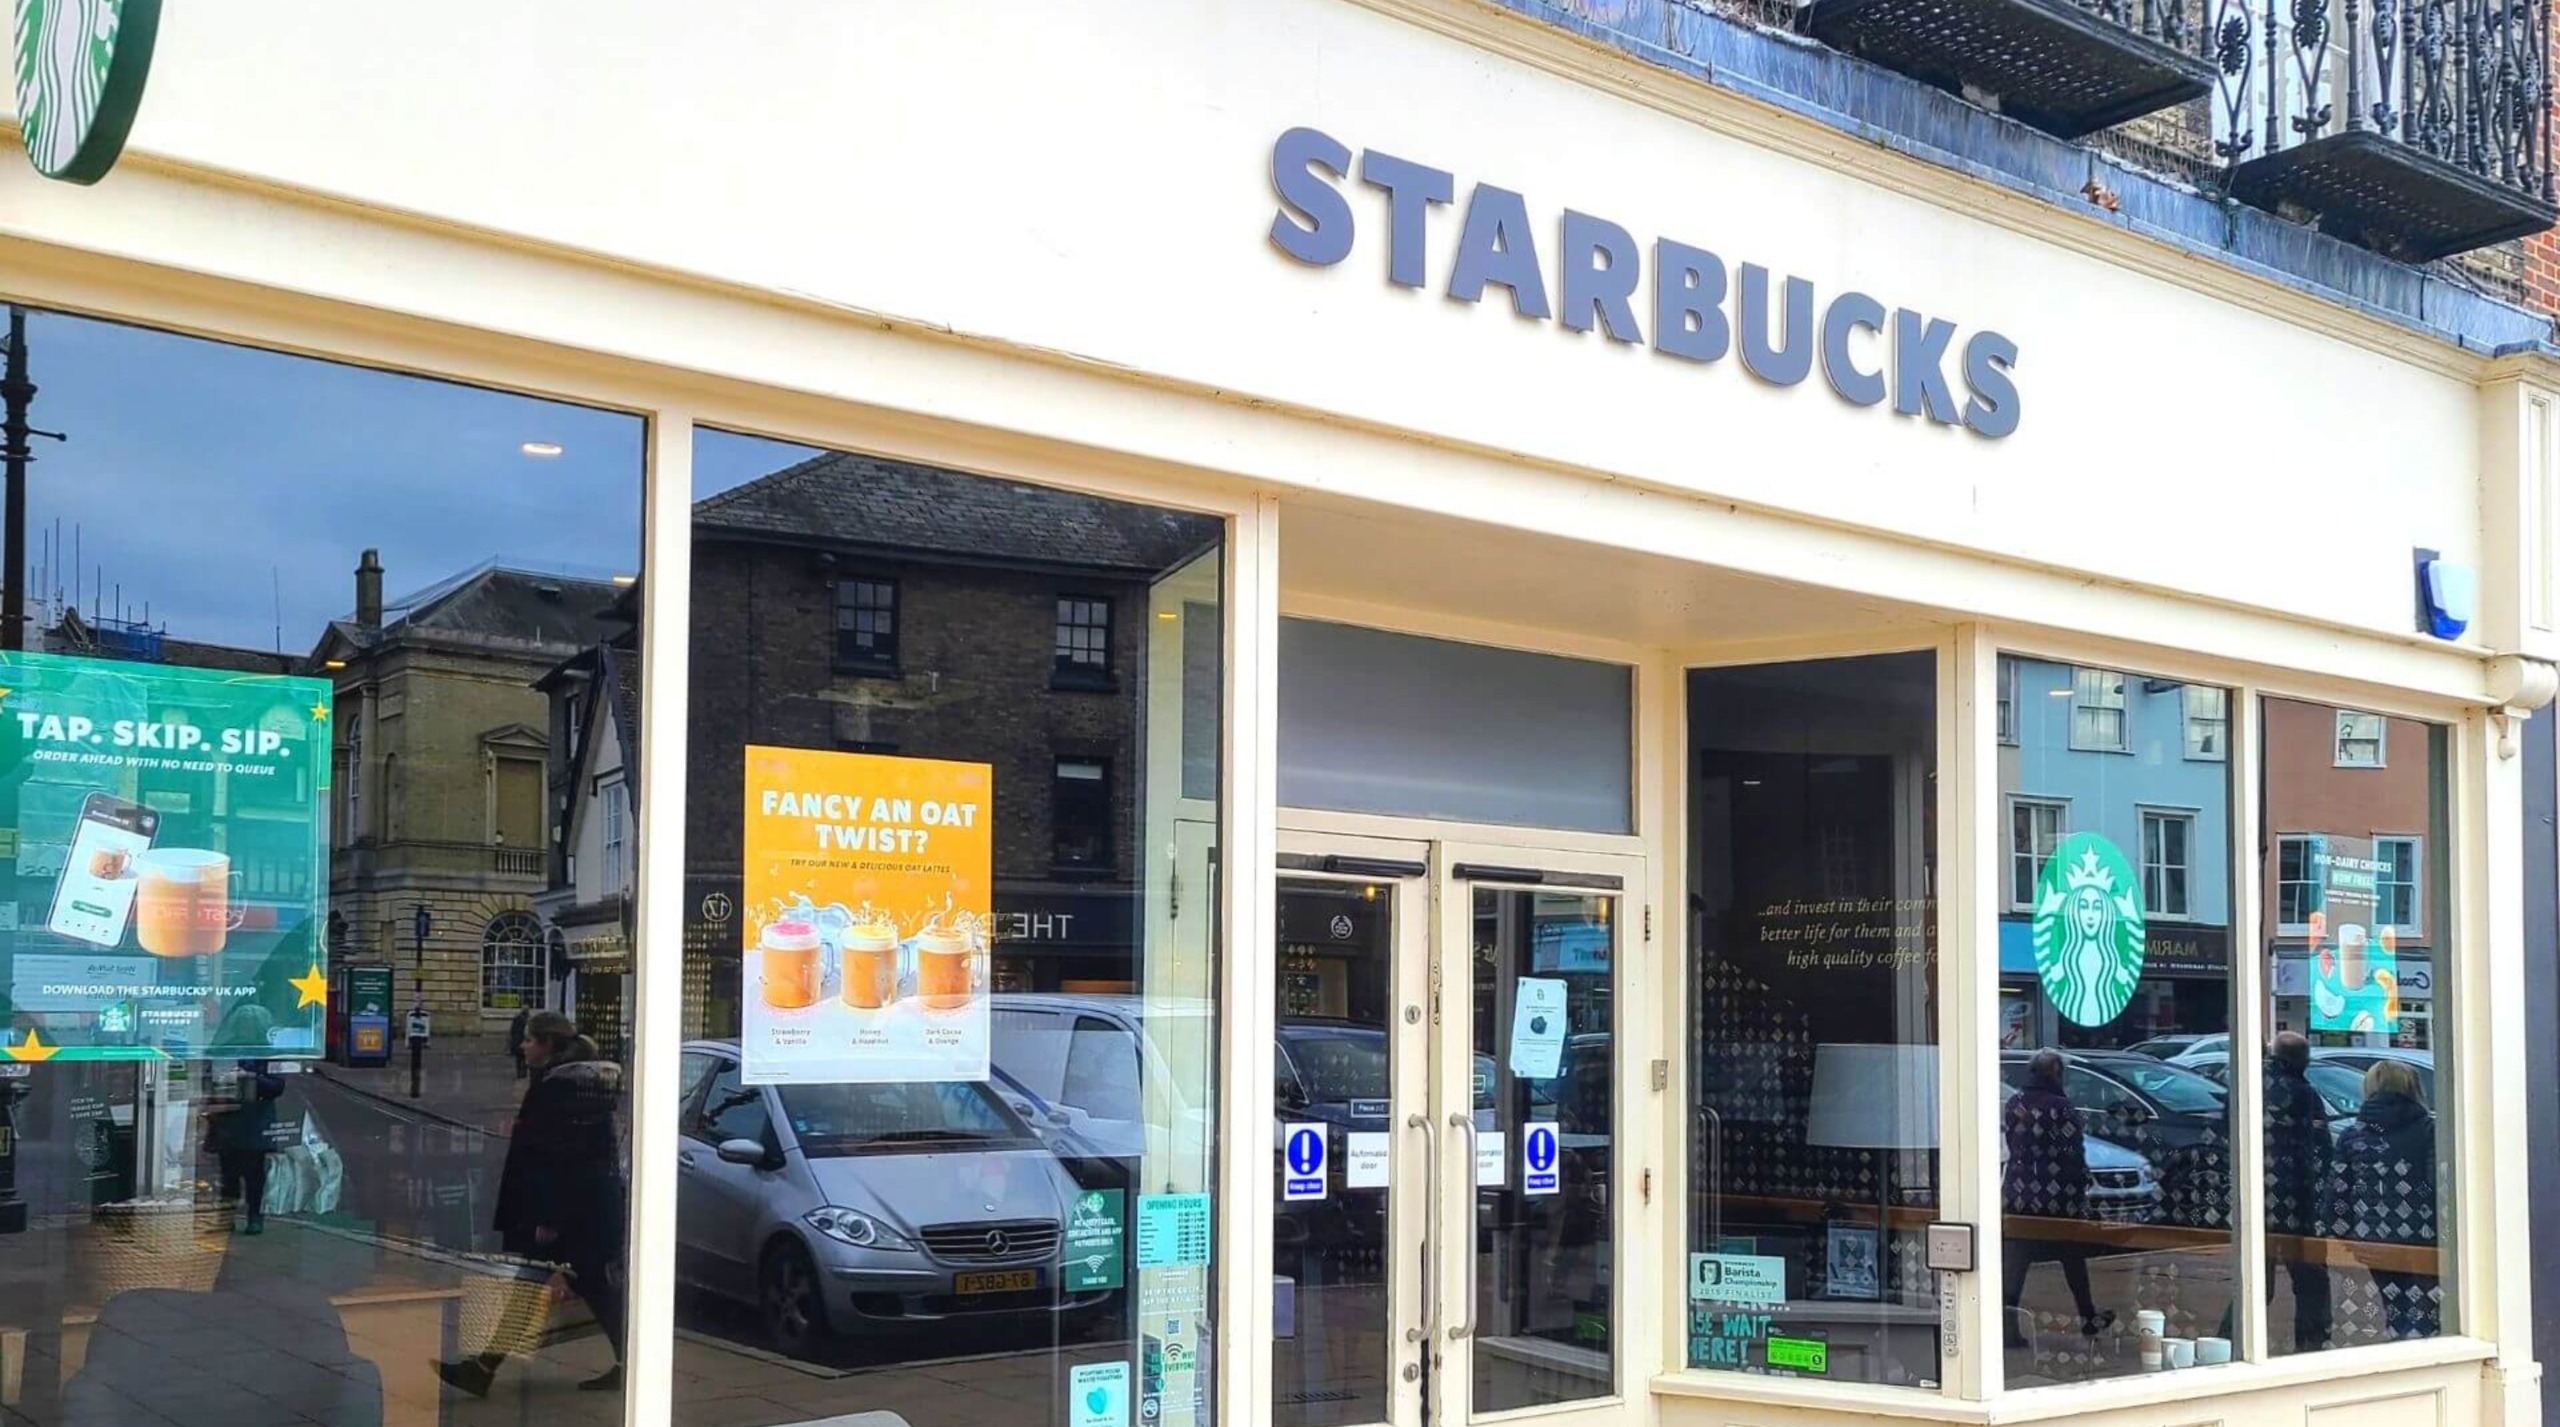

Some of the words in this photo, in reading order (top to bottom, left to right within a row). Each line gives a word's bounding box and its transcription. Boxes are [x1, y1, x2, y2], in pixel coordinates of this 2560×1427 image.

[1269, 126, 2021, 439] STARBUCKS
[16, 711, 104, 744] TAP.
[112, 719, 211, 752] SKIP.
[220, 727, 291, 758] SIP.
[33, 750, 78, 763] ORDER
[80, 752, 123, 766] AHEAD
[125, 756, 159, 768] WITH
[161, 758, 179, 770] NO
[183, 760, 214, 772] NEED
[216, 762, 232, 774] TO
[235, 763, 276, 776] QUEUE
[761, 789, 863, 821] FANCY
[869, 798, 912, 824] AN
[920, 801, 977, 828] OAT
[815, 823, 929, 854] TWIST?
[790, 858, 807, 867] TRY
[808, 860, 827, 868] OUR
[829, 860, 851, 869] NEW
[851, 861, 858, 869] &
[859, 862, 904, 871] DELICIOUS
[904, 864, 922, 872] OAT
[923, 865, 951, 873] LATTES
[2314, 853, 2360, 869] NON-DAIRY
[2360, 860, 2392, 873] CHOICES
[1794, 899, 1835, 914] invest
[1839, 897, 1853, 912] in
[1857, 897, 1892, 912] their
[1760, 925, 1801, 941] better
[1804, 924, 1826, 945] life
[1826, 922, 1850, 943] for
[1855, 923, 1890, 938] them
[1895, 919, 1923, 938] and
[1787, 949, 1820, 970] high
[1823, 948, 1873, 970] quality
[1877, 946, 1921, 970] coffee
[43, 984, 114, 996] DOWNLOAD
[117, 985, 140, 996] THE
[215, 986, 232, 997] UK
[234, 986, 257, 997] APP
[771, 1028, 811, 1037] Strawberry
[783, 1037, 807, 1045] Vanilla
[1360, 1162, 1378, 1170] door
[1146, 1199, 1177, 1211] OPENING
[1178, 1198, 1202, 1209] HOURS
[1724, 1266, 1761, 1277] Barista
[1724, 1277, 1777, 1289] Championship
[1725, 1289, 1772, 1299] FINALIST
[1722, 1312, 1772, 1339] WAIT
[1164, 1361, 1195, 1373] EVERYONE
